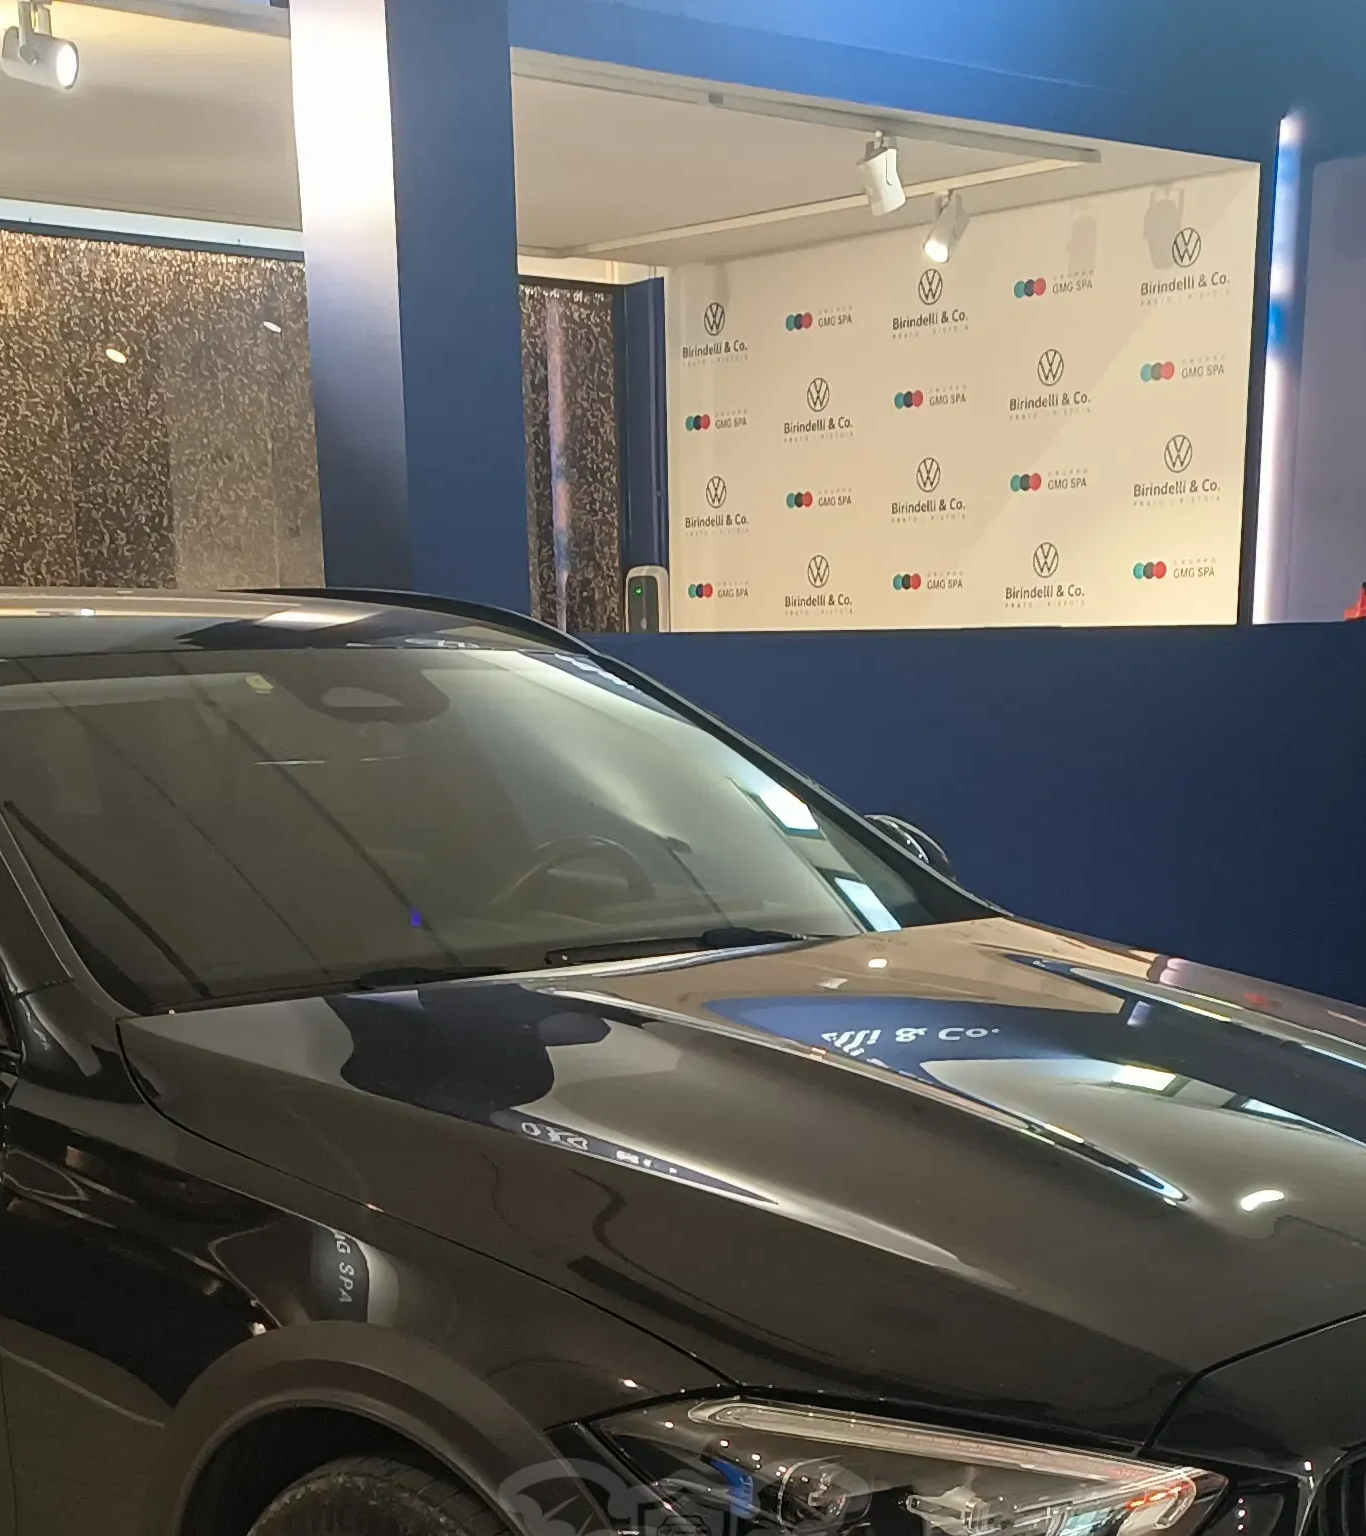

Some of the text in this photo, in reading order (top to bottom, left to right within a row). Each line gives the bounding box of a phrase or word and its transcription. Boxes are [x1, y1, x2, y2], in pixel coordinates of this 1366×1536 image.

[1141, 275, 1194, 296] Birindelli
[1198, 274, 1207, 287] &
[1211, 272, 1230, 286] Co.
[892, 312, 938, 330] Birindelli
[941, 310, 948, 324] &
[952, 308, 968, 322] Co.
[682, 342, 722, 358] Birindelli
[724, 341, 730, 353] &
[733, 340, 748, 352] Co.
[1010, 391, 1091, 411] Birindelli & Co.
[784, 416, 853, 434] Birindelli & Co.
[1134, 479, 1220, 497] Birindelli & Co.
[892, 497, 966, 514] Birindelli & Co.
[685, 513, 749, 528] Birindelli & Co.
[785, 594, 852, 608] Birindelli & Co.
[1005, 584, 1085, 600] Birindelli & Co.
